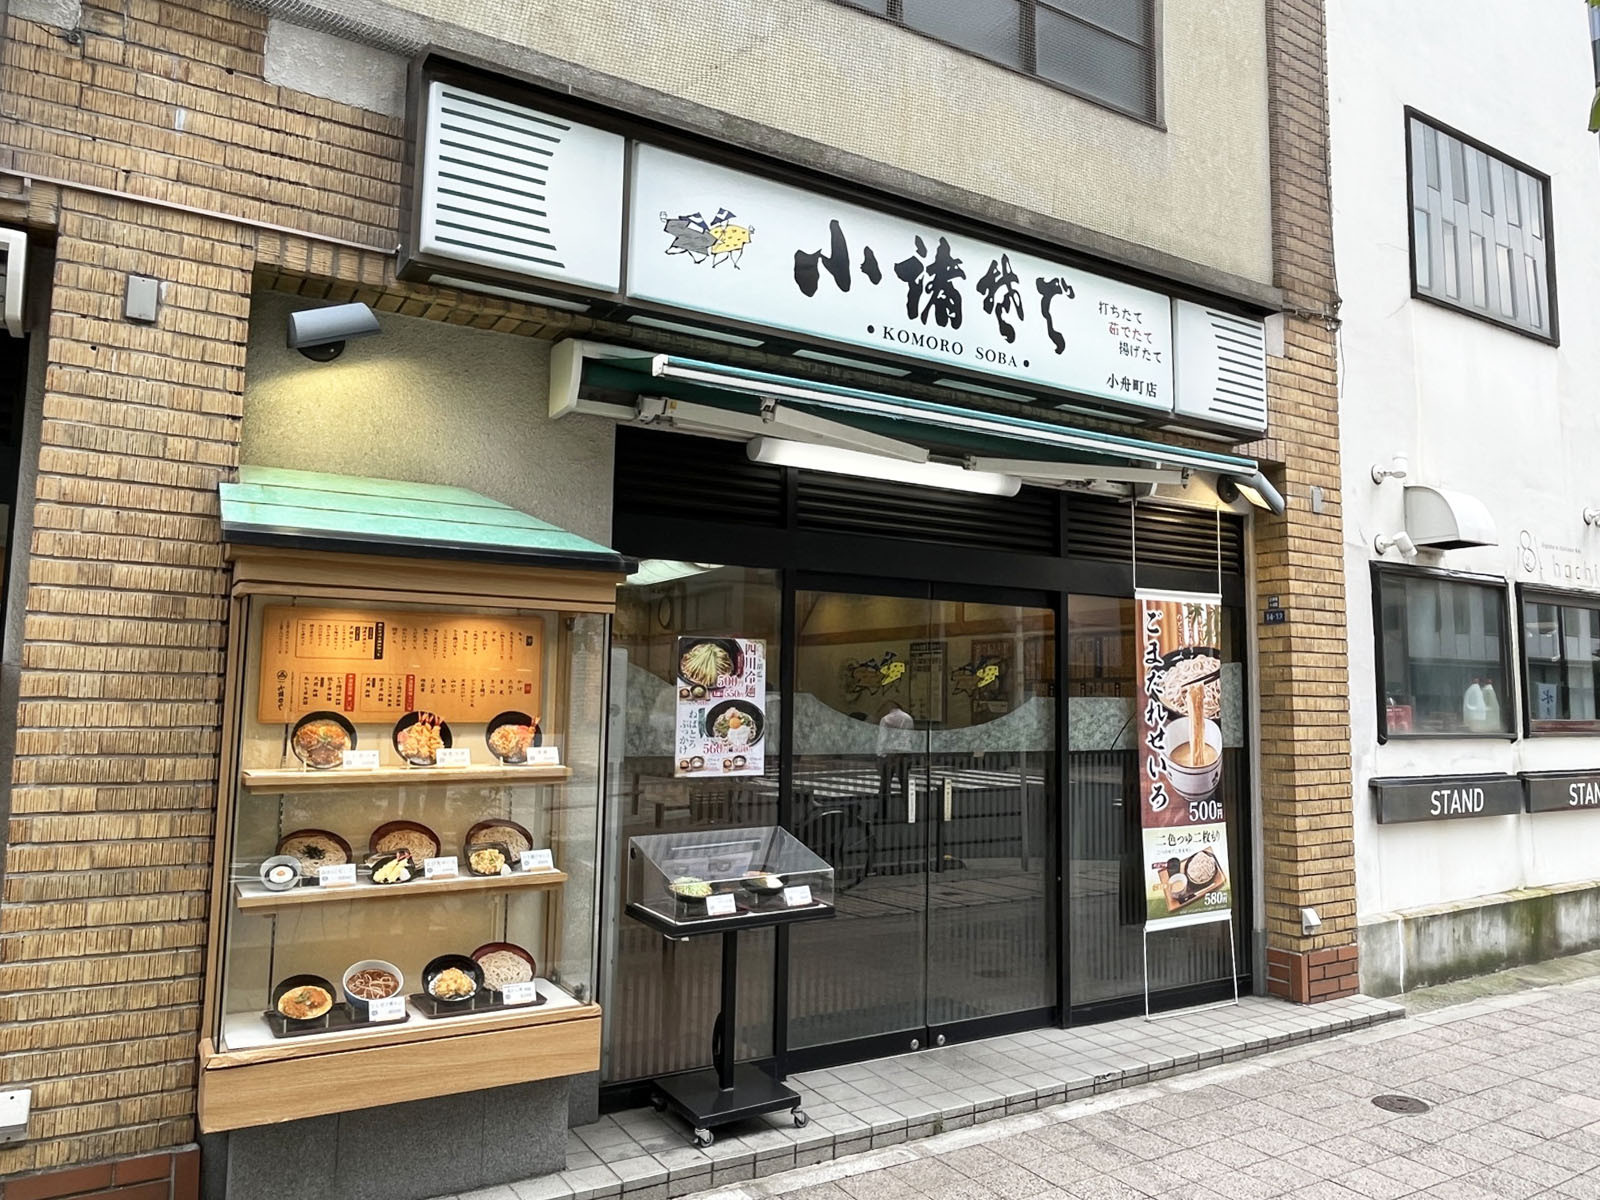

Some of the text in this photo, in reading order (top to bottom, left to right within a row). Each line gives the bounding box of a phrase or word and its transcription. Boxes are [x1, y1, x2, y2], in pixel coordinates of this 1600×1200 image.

[1098, 301, 1142, 325] 打ちたて
[1108, 321, 1152, 345] 茹でたて
[883, 326, 1017, 368] KOMORO SOBA
[1119, 341, 1162, 364] 揚げたて
[1106, 373, 1157, 398] 小舟町店
[1145, 611, 1168, 811] ごまだれせいろ
[1189, 800, 1224, 821] 500円
[1430, 788, 1485, 816] STAND
